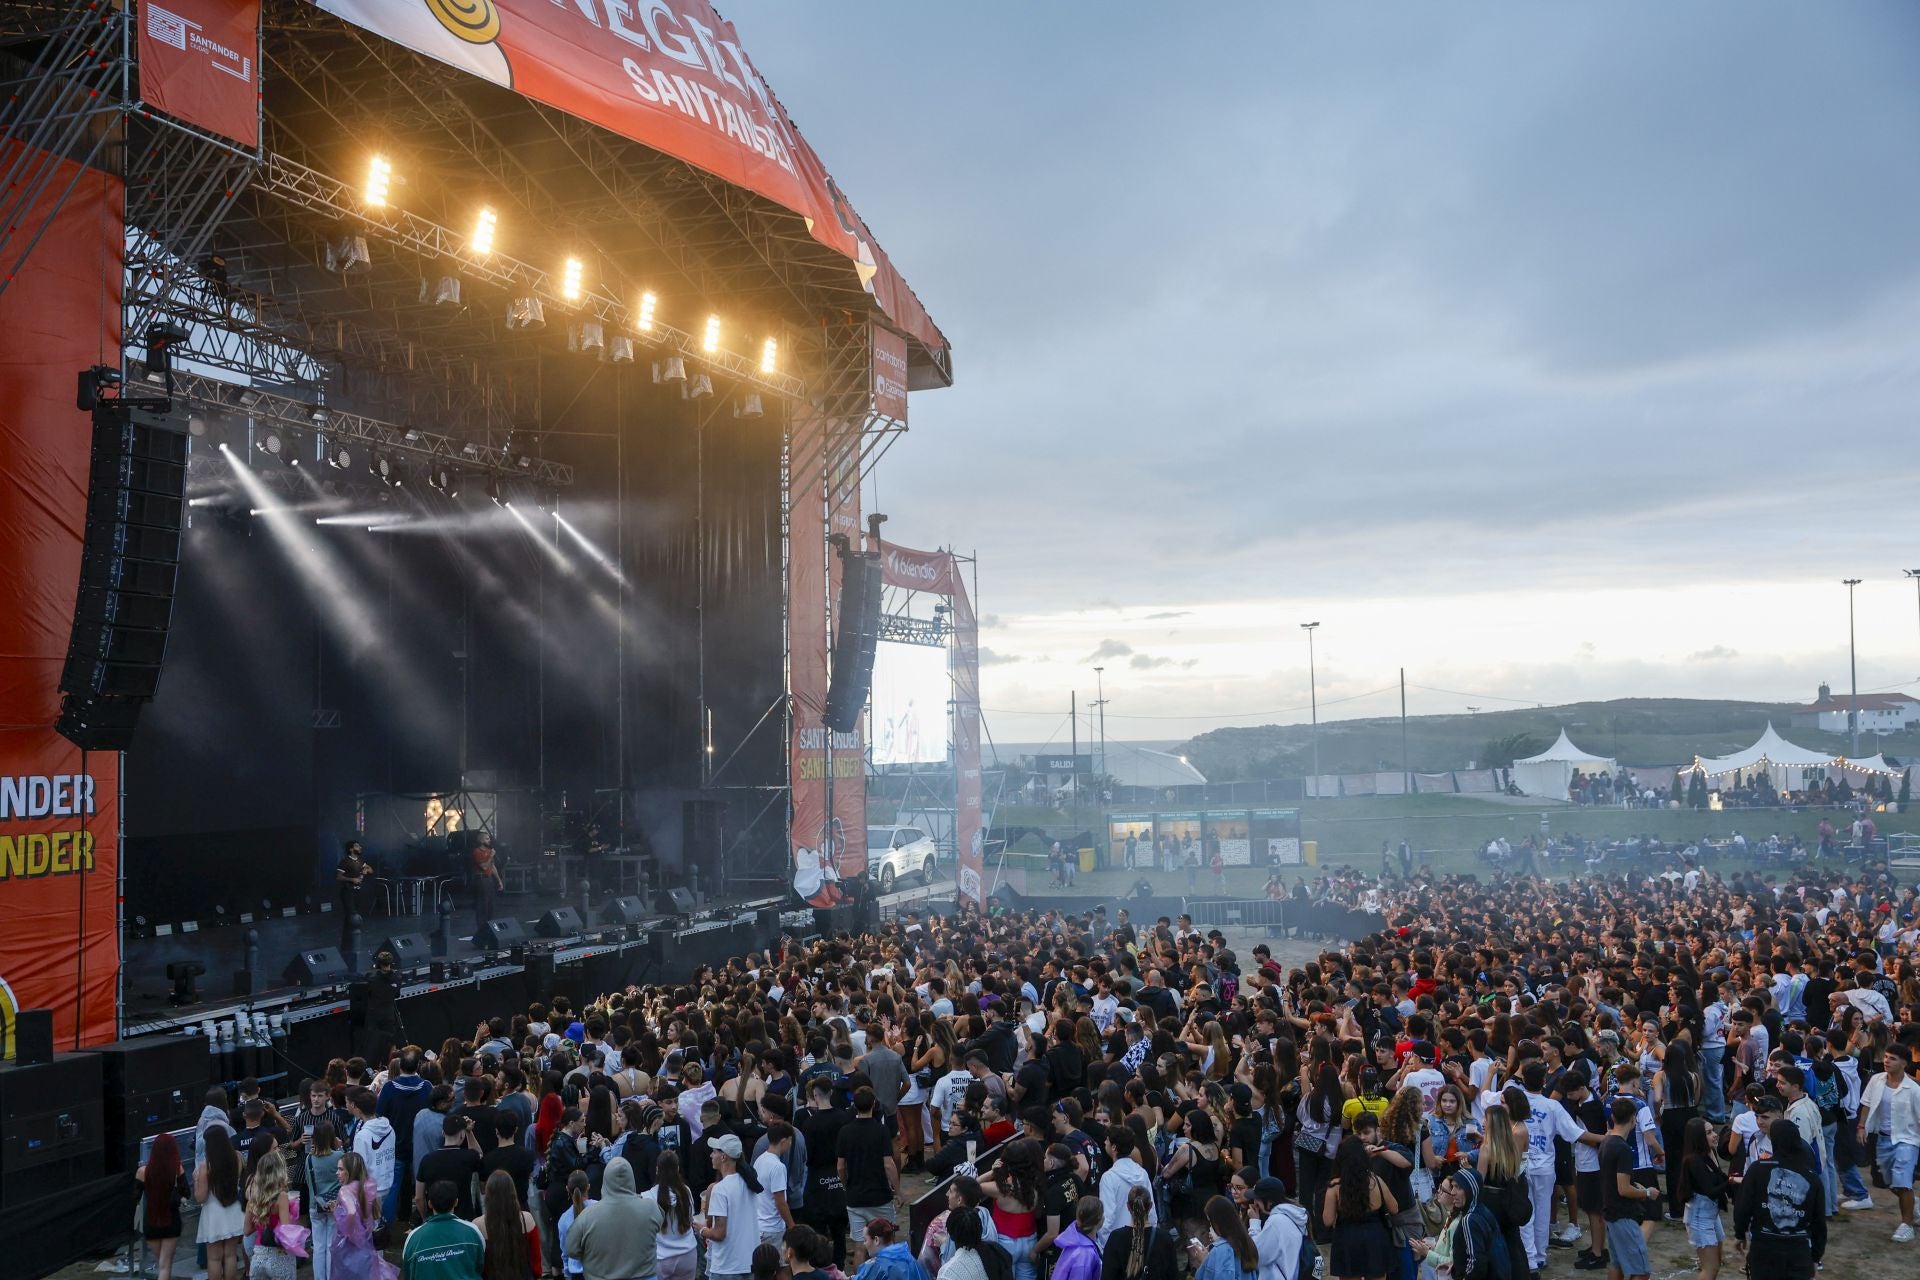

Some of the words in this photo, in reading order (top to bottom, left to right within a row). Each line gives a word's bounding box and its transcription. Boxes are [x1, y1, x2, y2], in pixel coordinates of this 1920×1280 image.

[190, 32, 240, 62] SANTANDER
[622, 57, 799, 181] SANTANDE
[951, 1077, 973, 1085] NOTHIN
